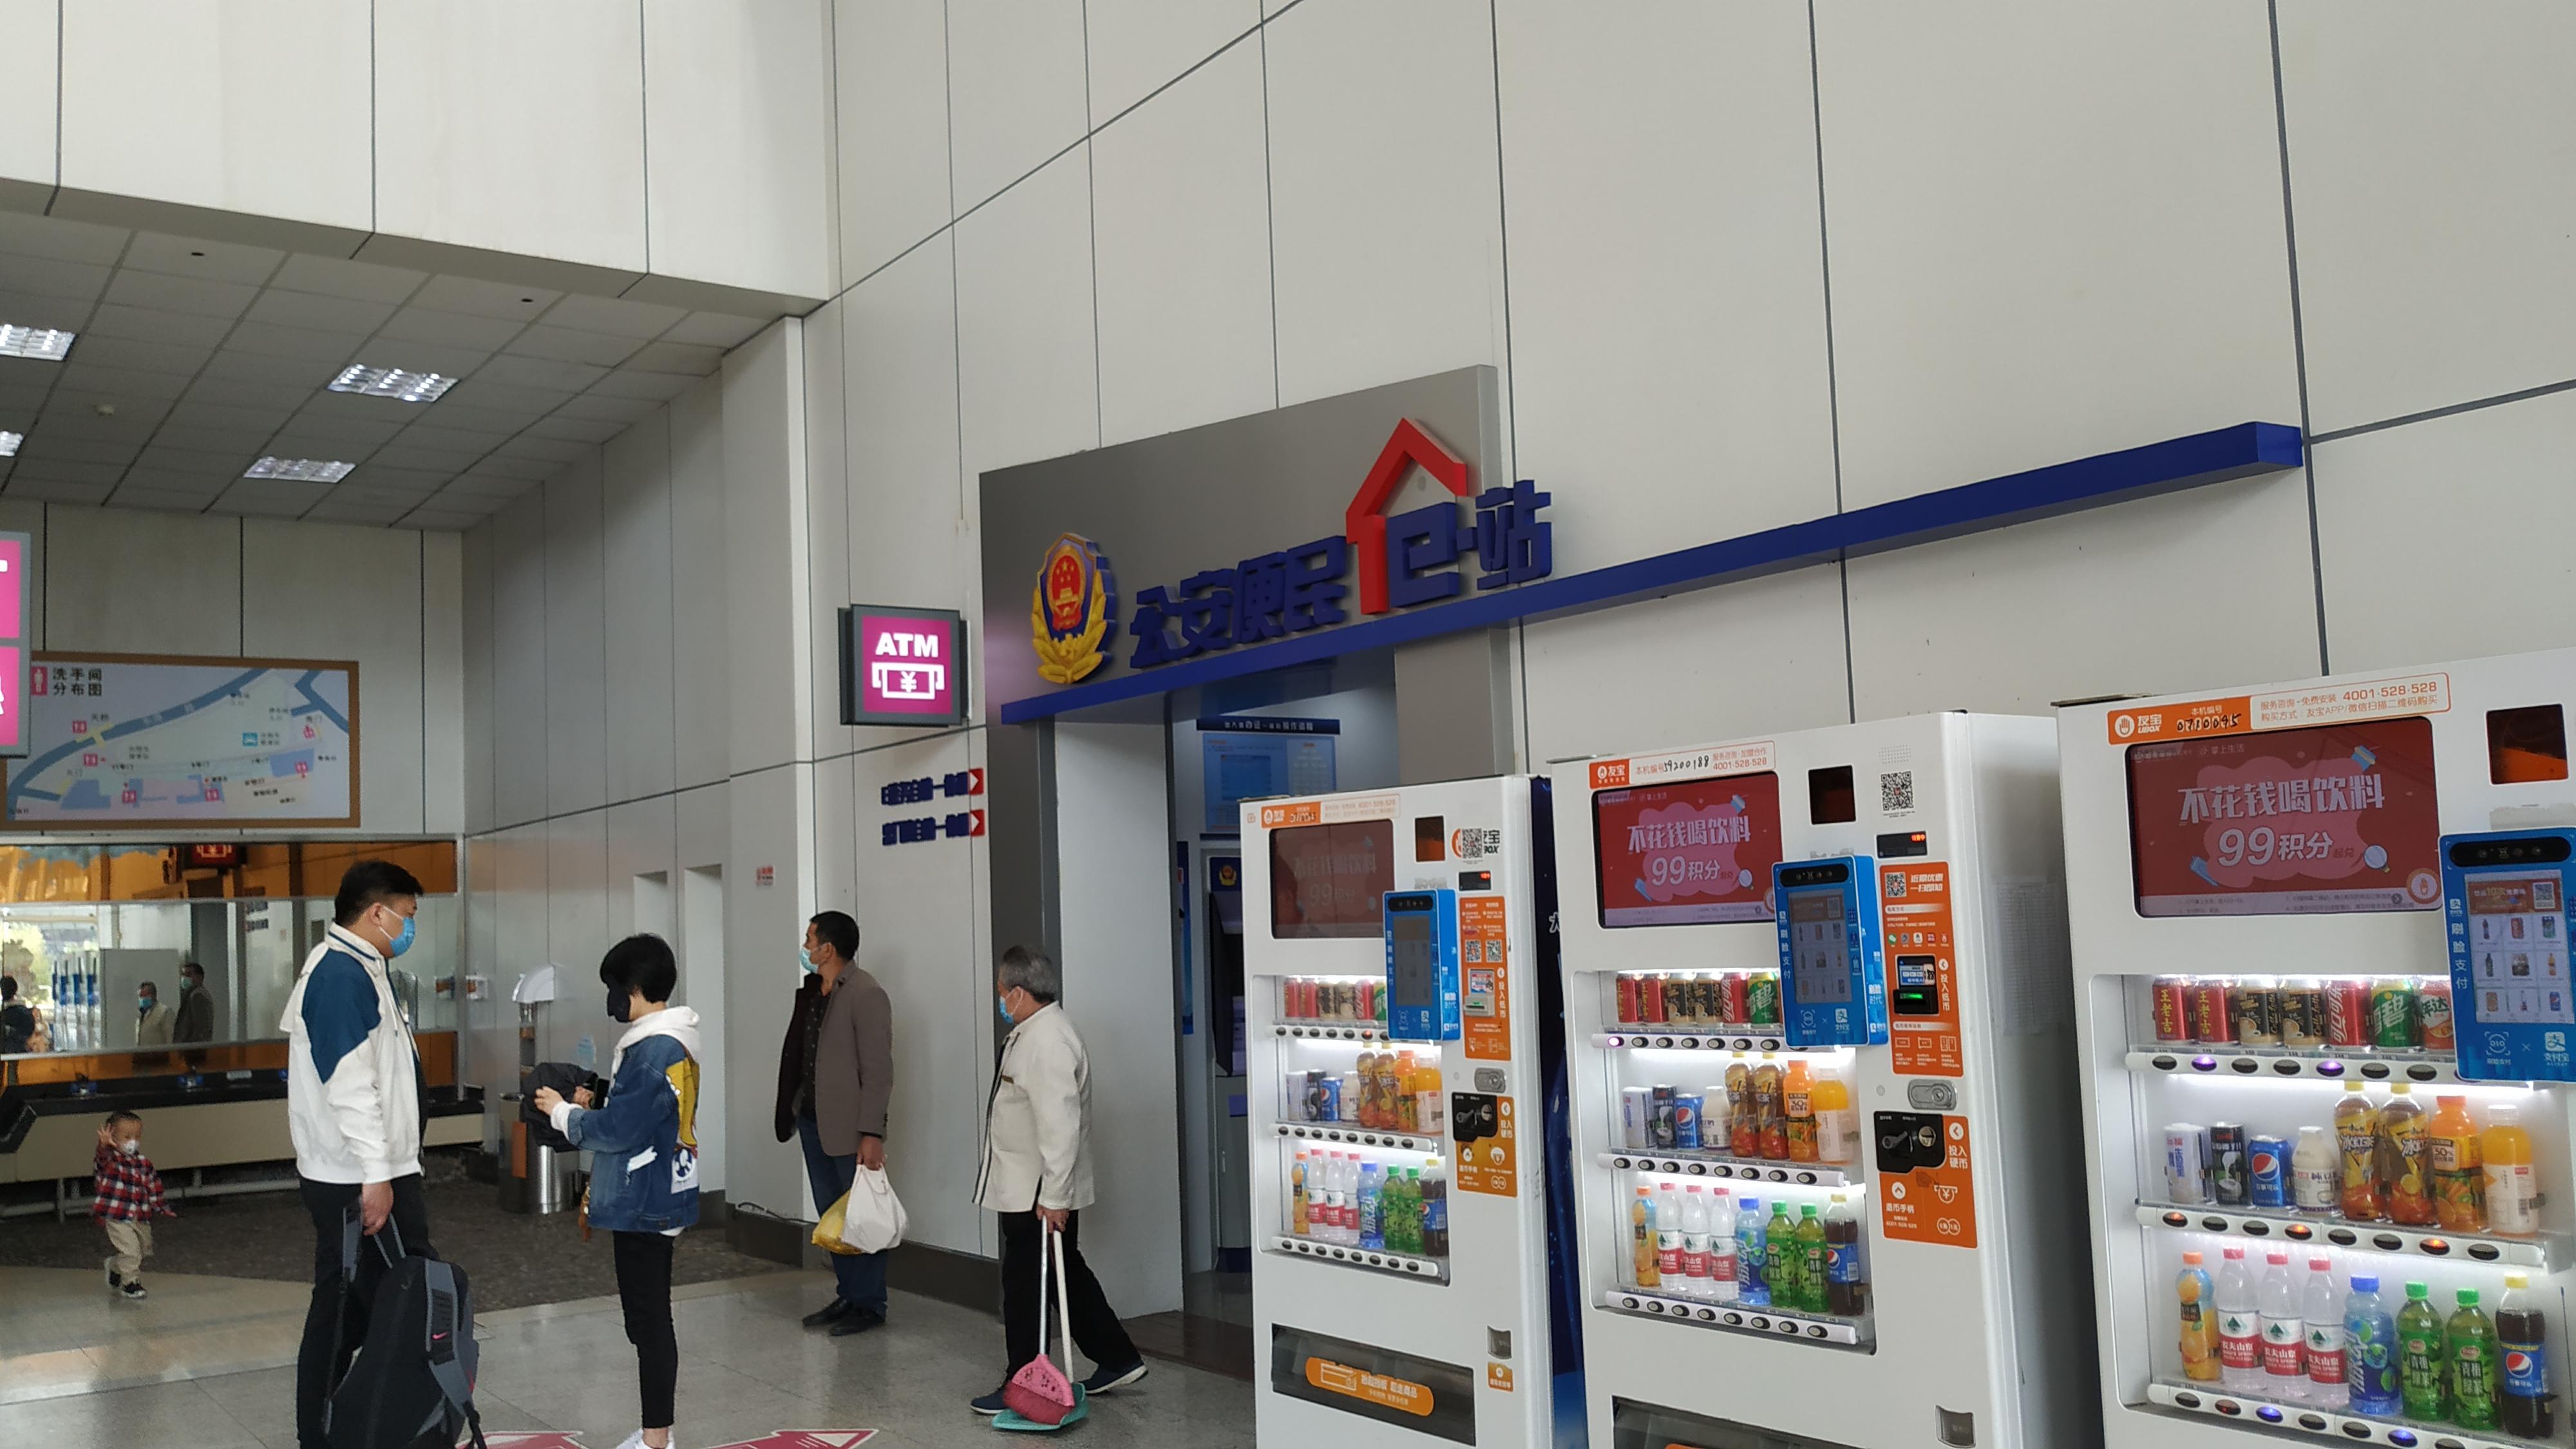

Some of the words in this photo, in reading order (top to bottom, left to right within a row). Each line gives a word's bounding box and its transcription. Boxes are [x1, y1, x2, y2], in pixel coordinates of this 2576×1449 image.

[875, 632, 938, 658] ATM
[53, 667, 102, 681] 洗手间
[53, 683, 102, 696] 分布图
[2137, 714, 2162, 727] 友宝
[2191, 705, 2222, 716] 本机编号
[2137, 726, 2161, 734] UBOX
[2210, 743, 2245, 755] 掌上生活
[1607, 764, 1625, 777] 友宝
[2178, 773, 2385, 826] 不花钱喝饮料
[1627, 815, 1751, 854] 不花钱喝饮料
[2219, 826, 2334, 867] 99积分
[2451, 922, 2468, 990] 刷脸支付
[1940, 974, 1950, 1011] 投入纸币
[2159, 989, 2173, 1034] 王老吉
[2199, 990, 2211, 1035] 王老吉
[2327, 986, 2348, 1044] 可口可乐
[2372, 994, 2407, 1037] 雪碧
[2544, 1052, 2570, 1062] 支付宝
[1949, 1144, 1967, 1157] 投入
[1949, 1157, 1968, 1170] 硬币
